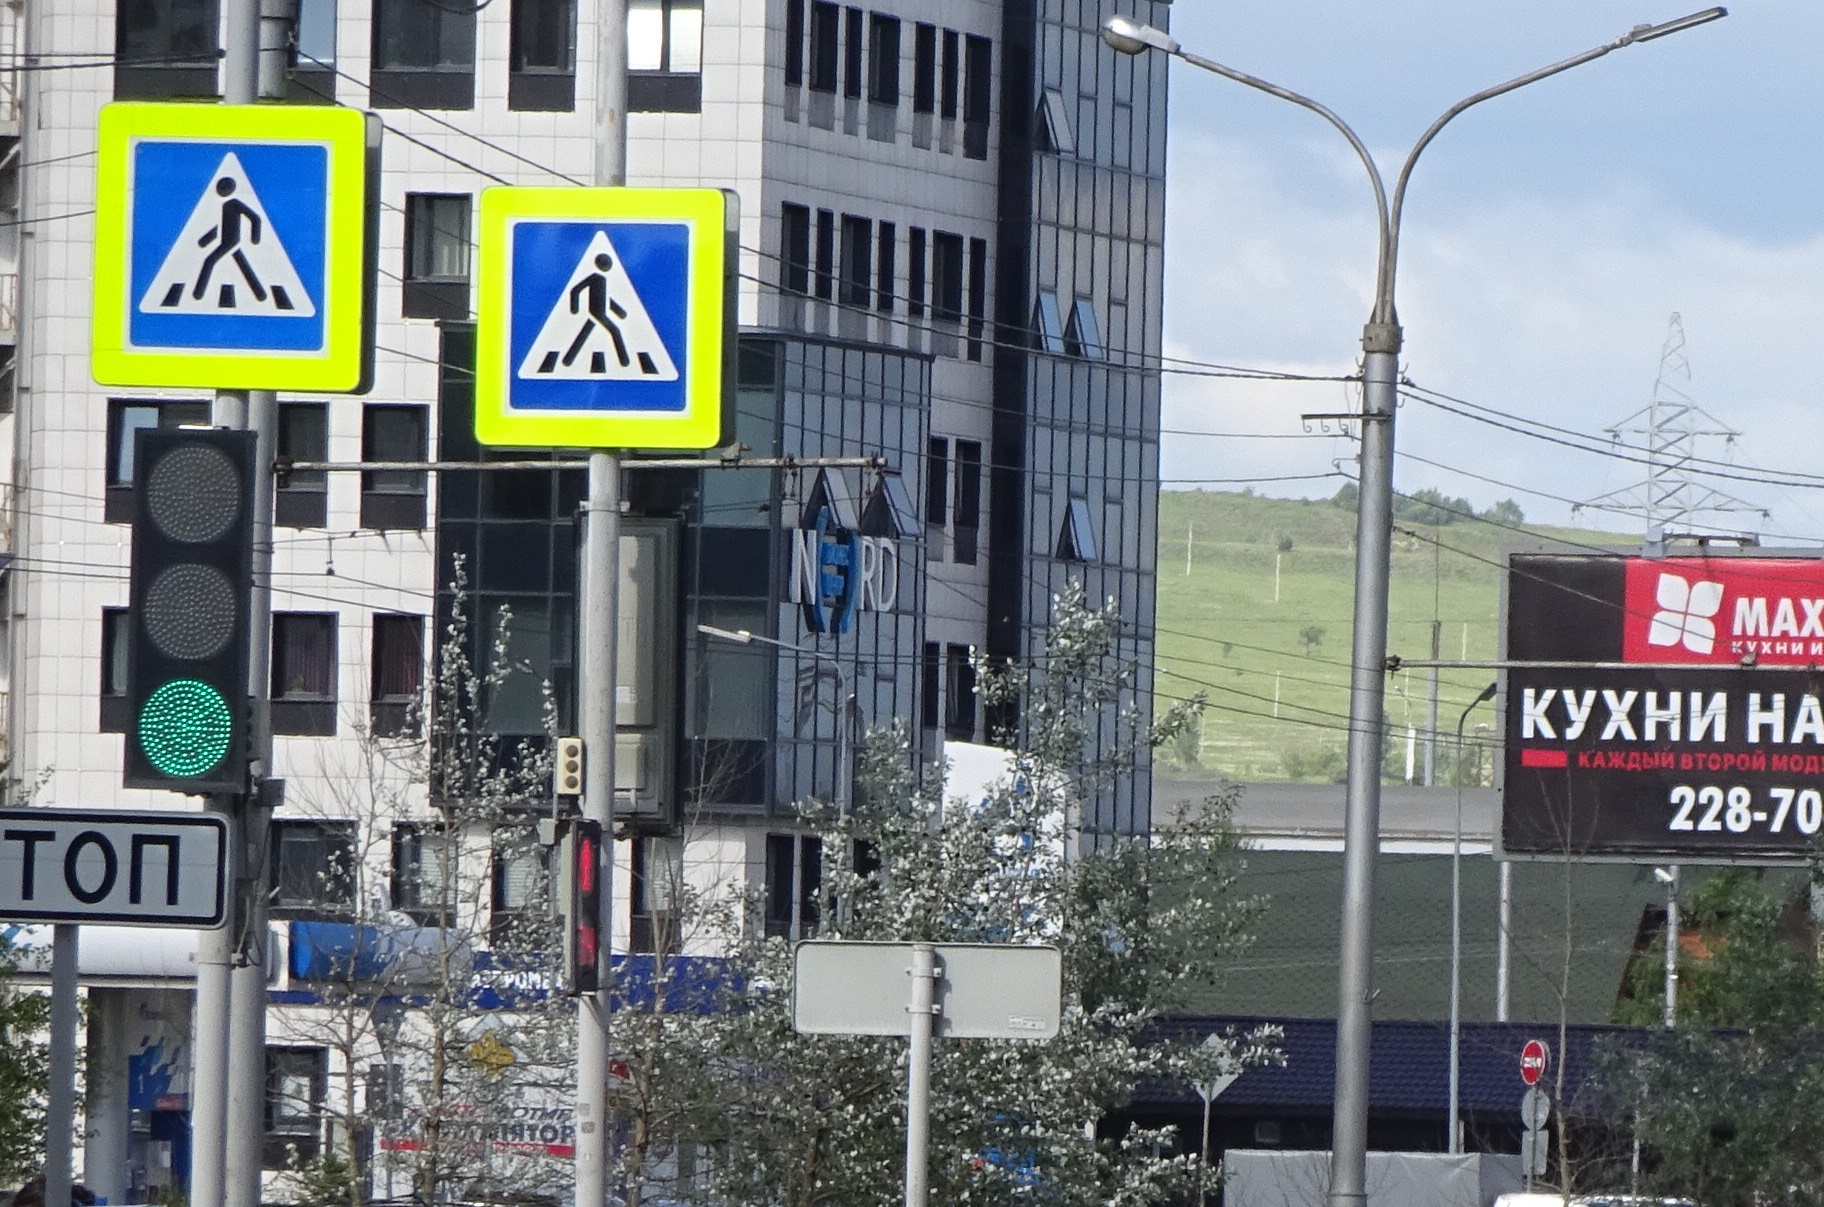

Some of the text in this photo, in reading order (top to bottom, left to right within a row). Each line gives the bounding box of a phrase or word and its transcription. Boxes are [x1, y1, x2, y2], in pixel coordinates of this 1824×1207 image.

[1732, 641, 1803, 656] КУХНИ
[1810, 642, 1823, 656] И
[1521, 688, 1727, 743] КУХНИ
[1578, 749, 1675, 771] КАЖДЫЙ
[1680, 750, 1766, 772] ВТОРОЙ
[3, 829, 180, 906] ТОП
